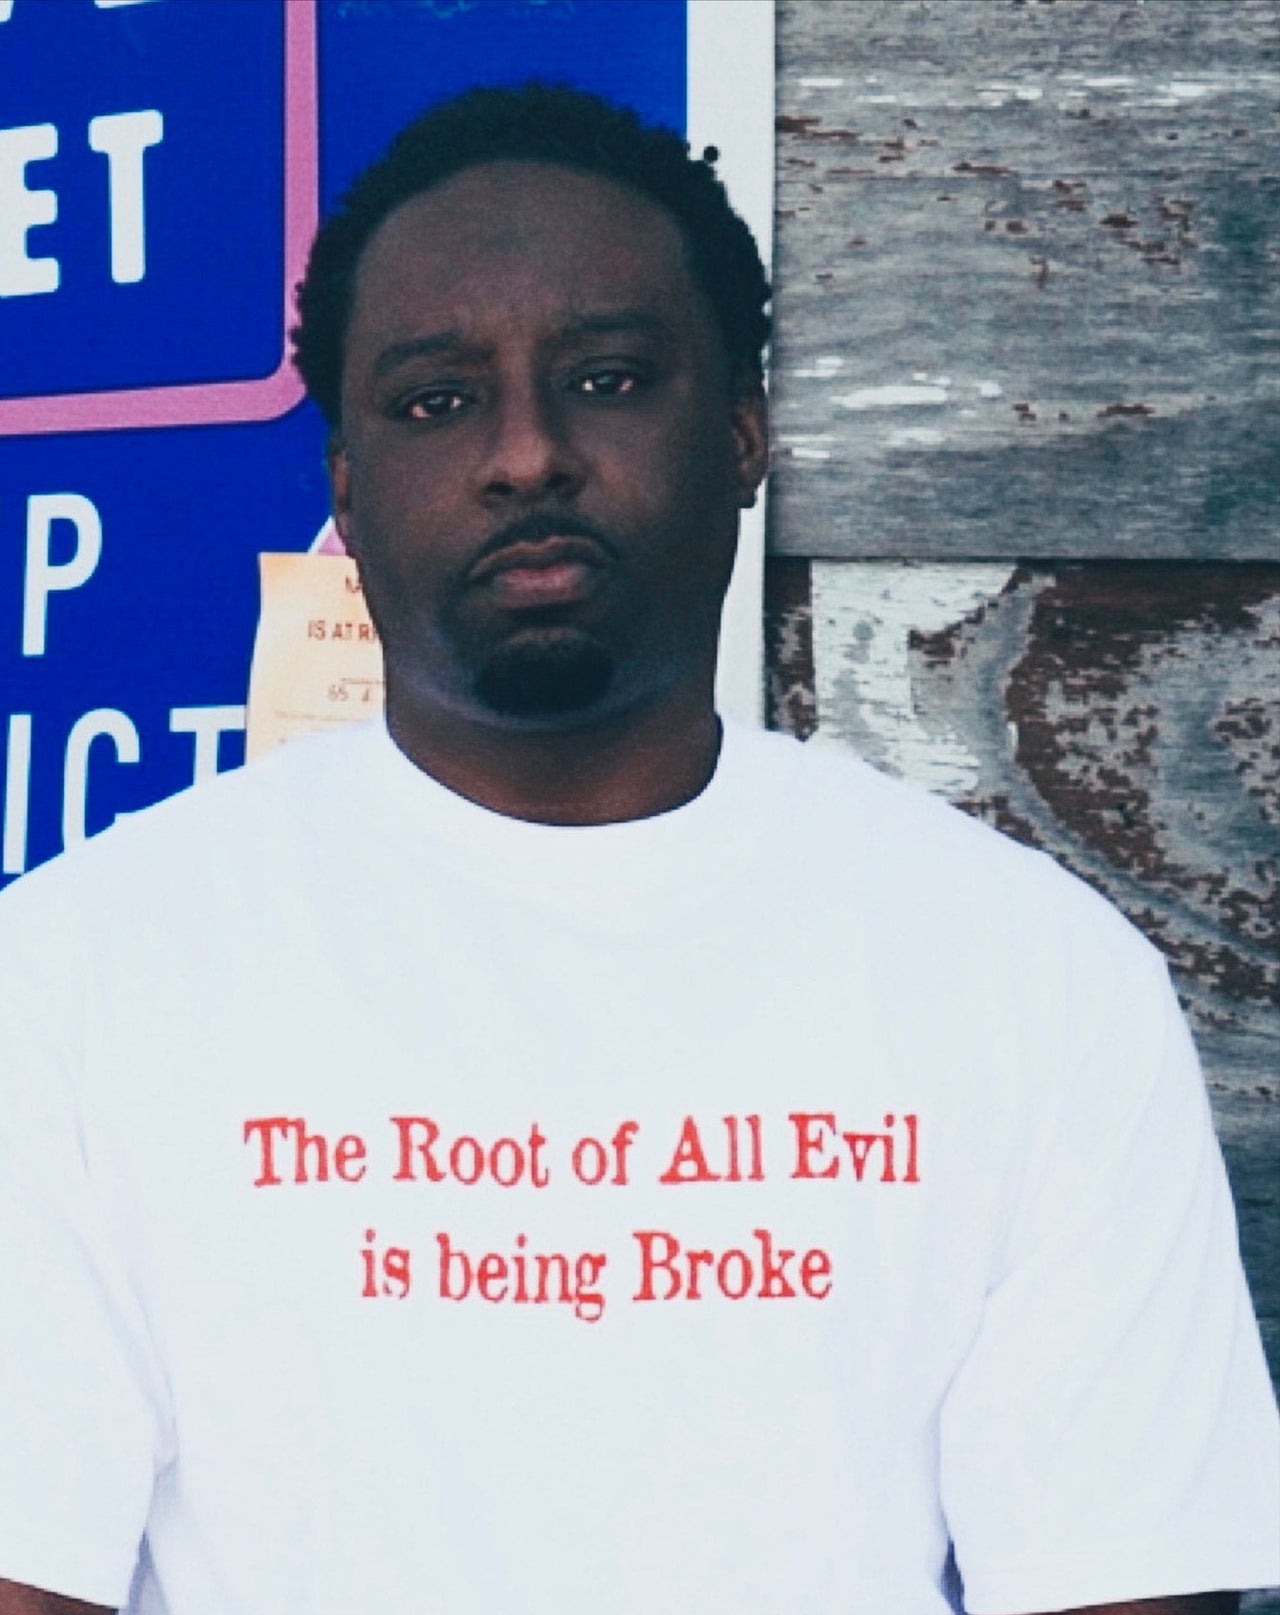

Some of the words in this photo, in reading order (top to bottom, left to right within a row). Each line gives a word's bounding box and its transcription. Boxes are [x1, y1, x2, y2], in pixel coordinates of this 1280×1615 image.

[243, 1116, 366, 1187] The
[391, 1116, 549, 1188] Root
[571, 1120, 639, 1186] of
[659, 1114, 764, 1185] All
[788, 1112, 919, 1184] Evil
[360, 1229, 411, 1299] is
[435, 1232, 607, 1322] being
[633, 1228, 832, 1302] Broke
